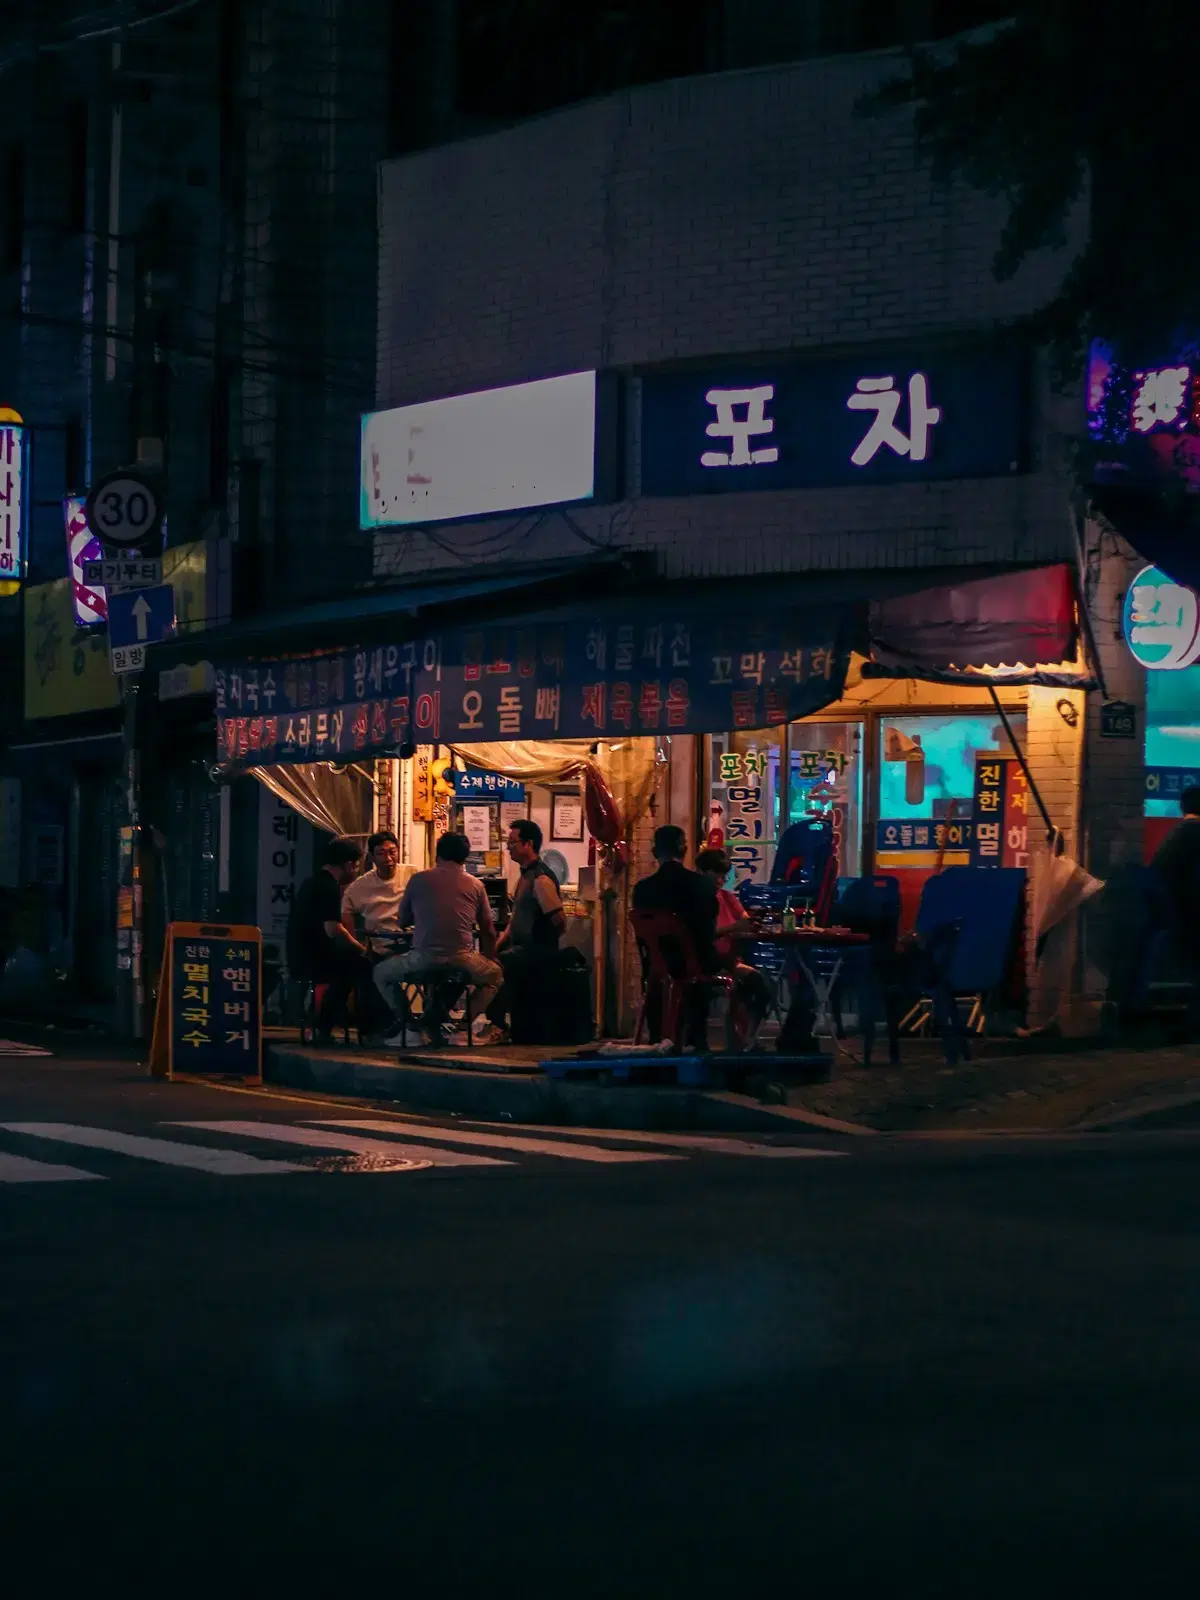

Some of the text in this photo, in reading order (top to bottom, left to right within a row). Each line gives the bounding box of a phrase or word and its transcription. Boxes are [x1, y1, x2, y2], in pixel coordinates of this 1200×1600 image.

[700, 372, 940, 466] 포차
[101, 491, 148, 527] 30
[89, 562, 157, 581] 여기부터
[114, 647, 143, 669] 일방
[459, 683, 561, 733] 오돌뼈
[720, 752, 767, 780] 포차
[800, 751, 848, 778] 포차
[977, 764, 1001, 812] 진한
[727, 785, 763, 887] 멸치국
[184, 944, 211, 959] 진한
[224, 947, 251, 961] 수제
[181, 963, 212, 1049] 멸치국수
[222, 967, 251, 1050] 햄버거
